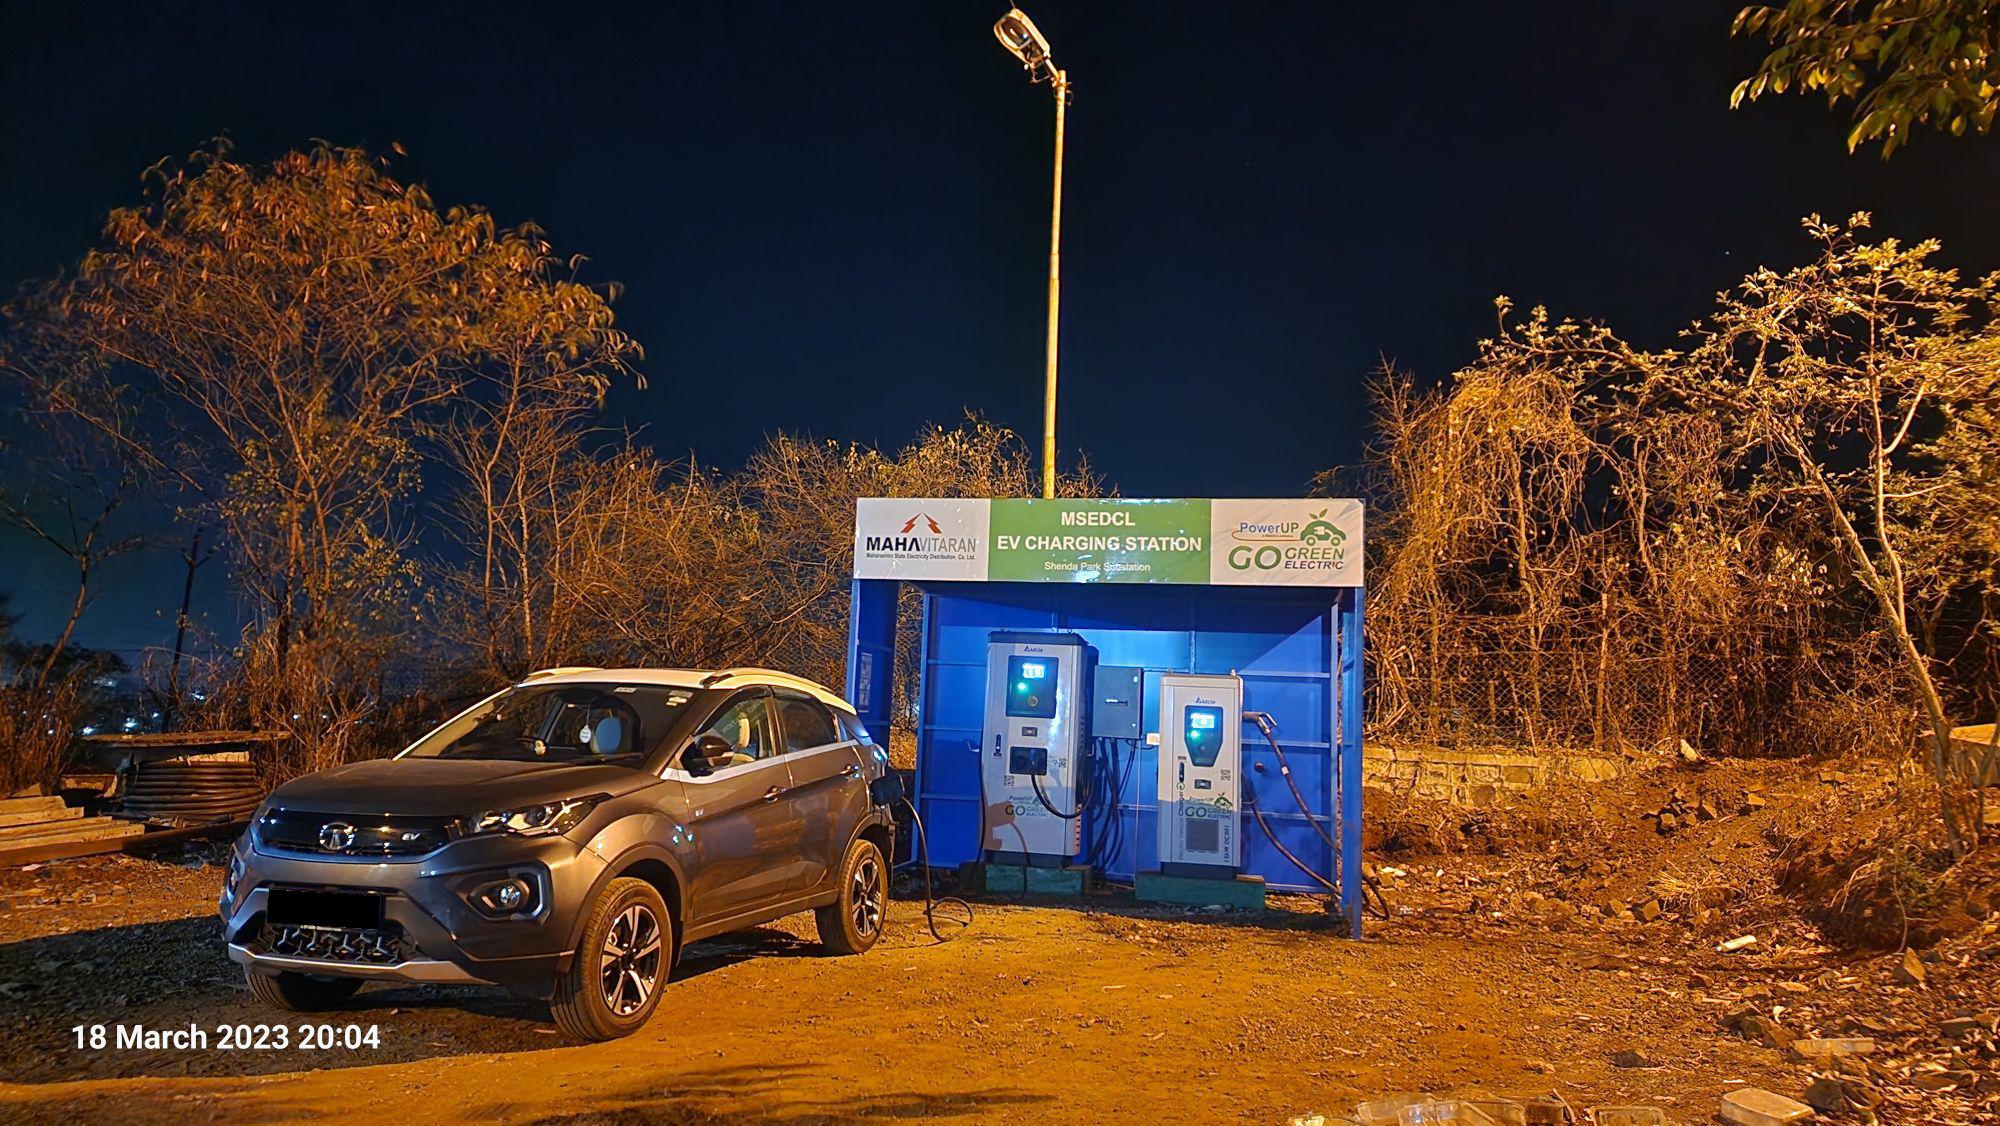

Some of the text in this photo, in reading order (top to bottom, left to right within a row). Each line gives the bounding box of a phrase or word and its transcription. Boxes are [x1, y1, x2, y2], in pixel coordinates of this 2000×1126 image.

[1061, 512, 1135, 526] MSEDCL
[1240, 522, 1299, 534] PowerUP
[866, 537, 976, 553] MAHAVITARAN
[997, 535, 1202, 552] EV CHARGING STATION
[1228, 545, 1345, 570] GO GREEN
[1044, 561, 1151, 573] Shenda Park Substation
[1284, 560, 1344, 570] ELECTRIC
[1185, 806, 1207, 818] GO
